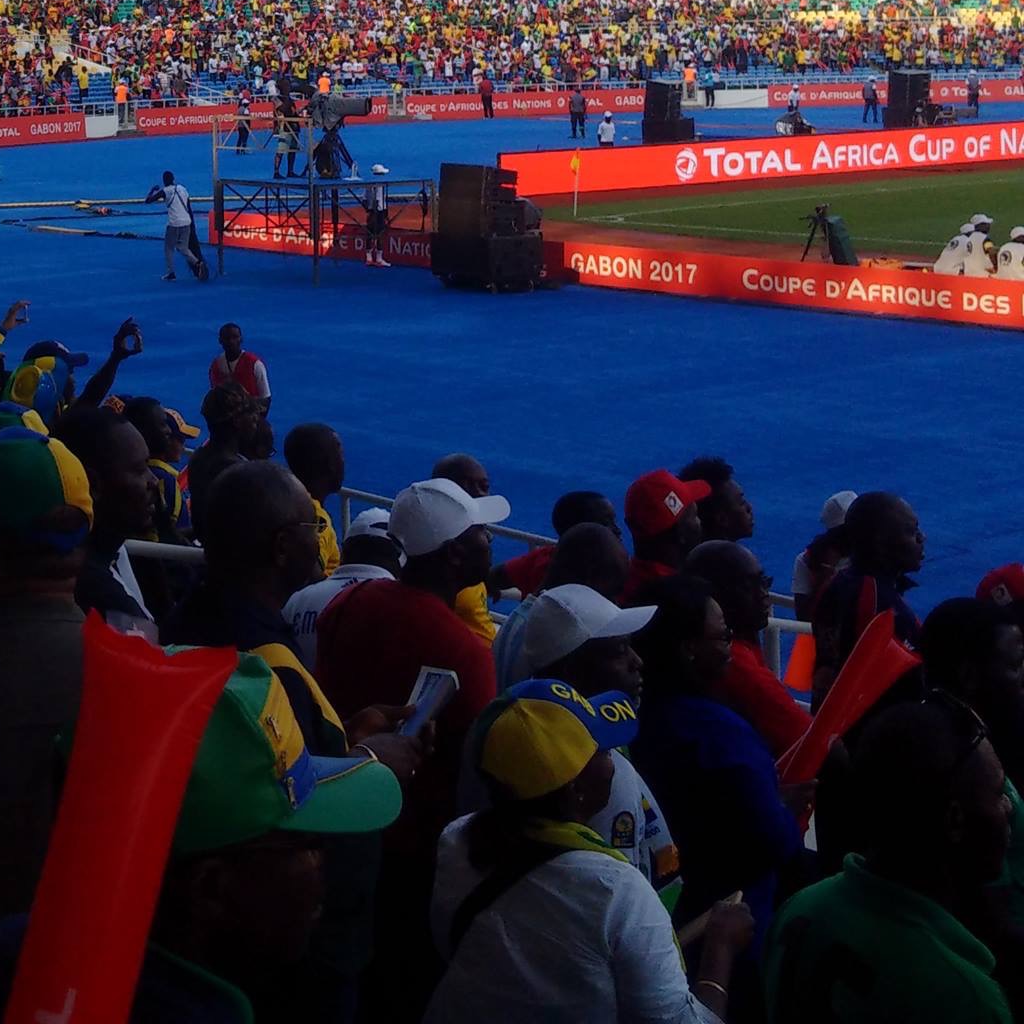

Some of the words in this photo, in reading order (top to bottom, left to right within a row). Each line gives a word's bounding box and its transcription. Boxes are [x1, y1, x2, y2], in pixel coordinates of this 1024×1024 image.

[371, 104, 387, 115] 017
[407, 102, 436, 114] COUPE
[440, 101, 483, 112] D'AFRIQU
[513, 98, 552, 109] NATIONS
[615, 95, 644, 106] GABO
[30, 123, 61, 135] GABON
[63, 121, 81, 133] 2017
[139, 116, 167, 128] COUPE
[703, 147, 802, 177] TOTAL
[812, 140, 900, 170] AFRICA
[908, 134, 955, 163] CUP
[964, 135, 991, 158] OF
[571, 253, 642, 280] GABON
[650, 261, 697, 284] 2017
[742, 268, 816, 296] COUPE
[826, 278, 952, 309] D'AFRIQUE
[962, 292, 1010, 315] DES
[550, 683, 636, 722] GABON
